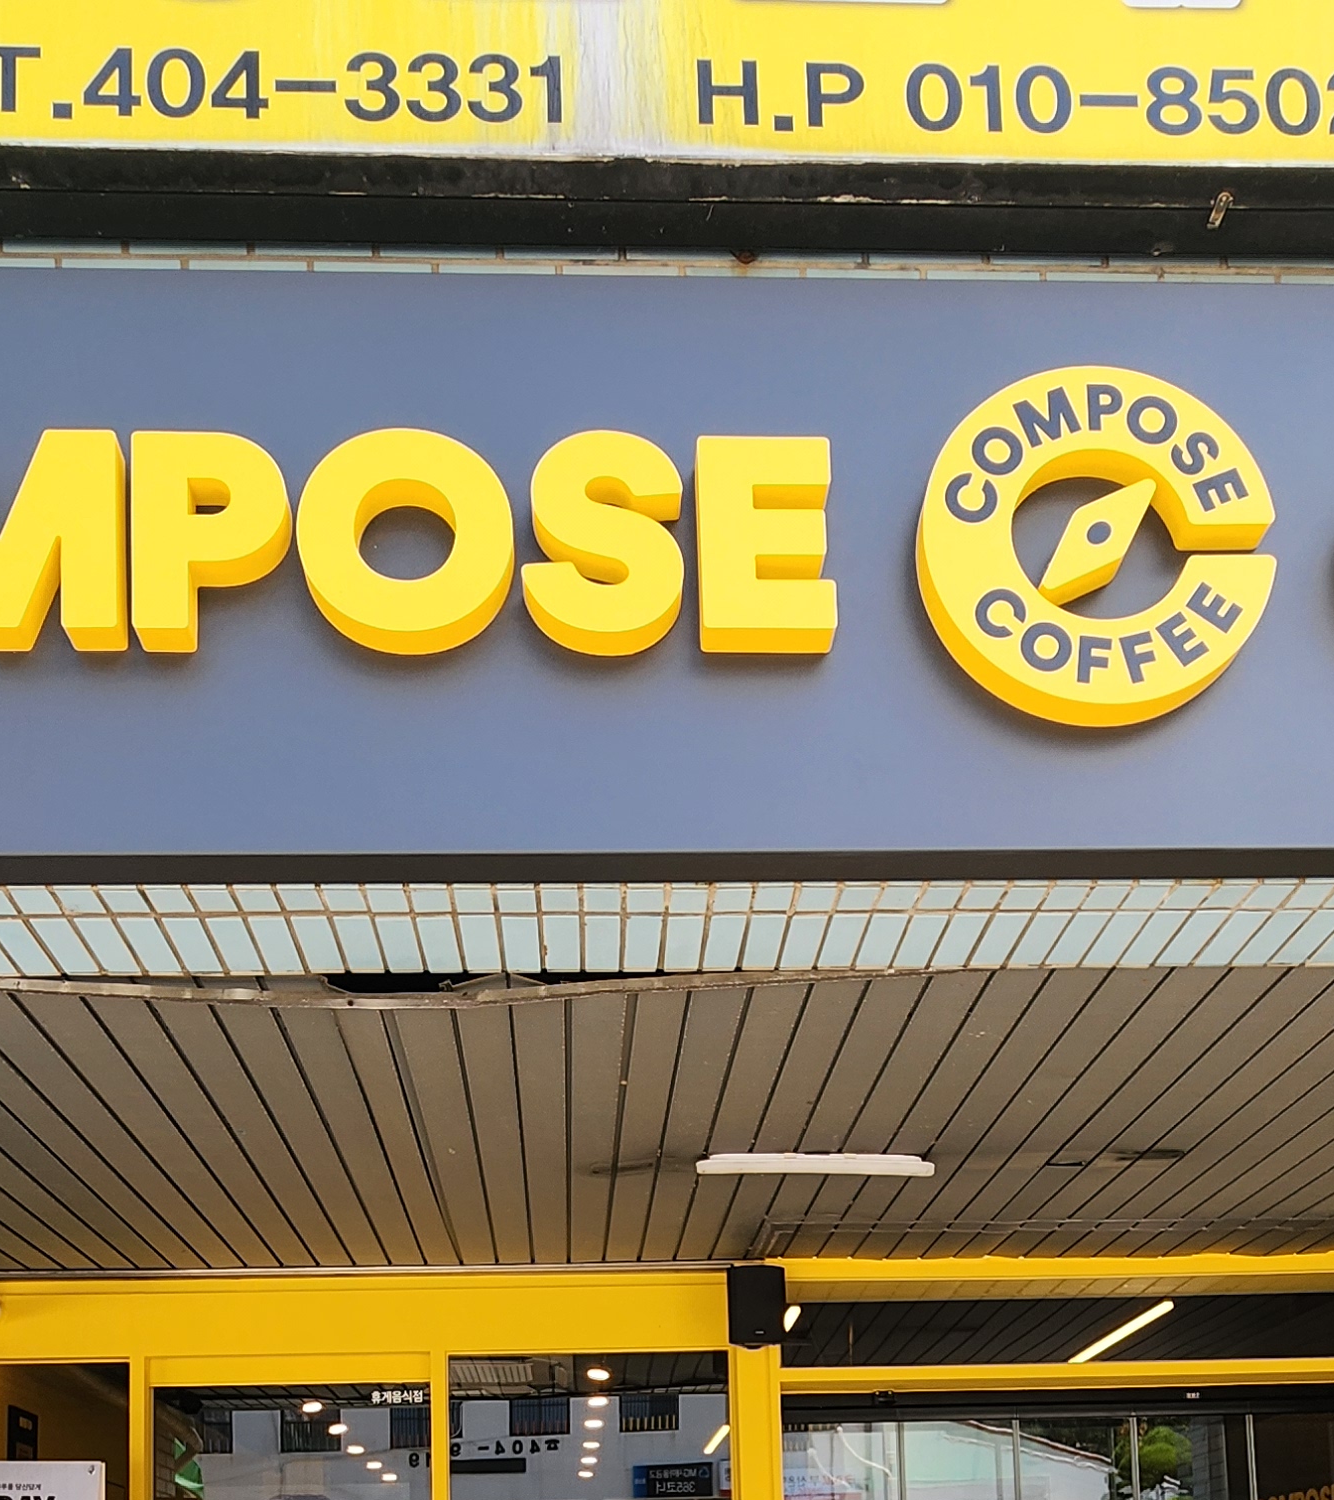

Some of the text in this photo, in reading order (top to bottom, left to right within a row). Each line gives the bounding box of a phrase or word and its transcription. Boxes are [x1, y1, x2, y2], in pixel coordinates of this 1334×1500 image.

[695, 59, 866, 132] H.P
[944, 383, 1249, 524] COMPOSE
[975, 581, 1244, 685] COFFEE
[371, 1390, 423, 1404] 휴게음식점
